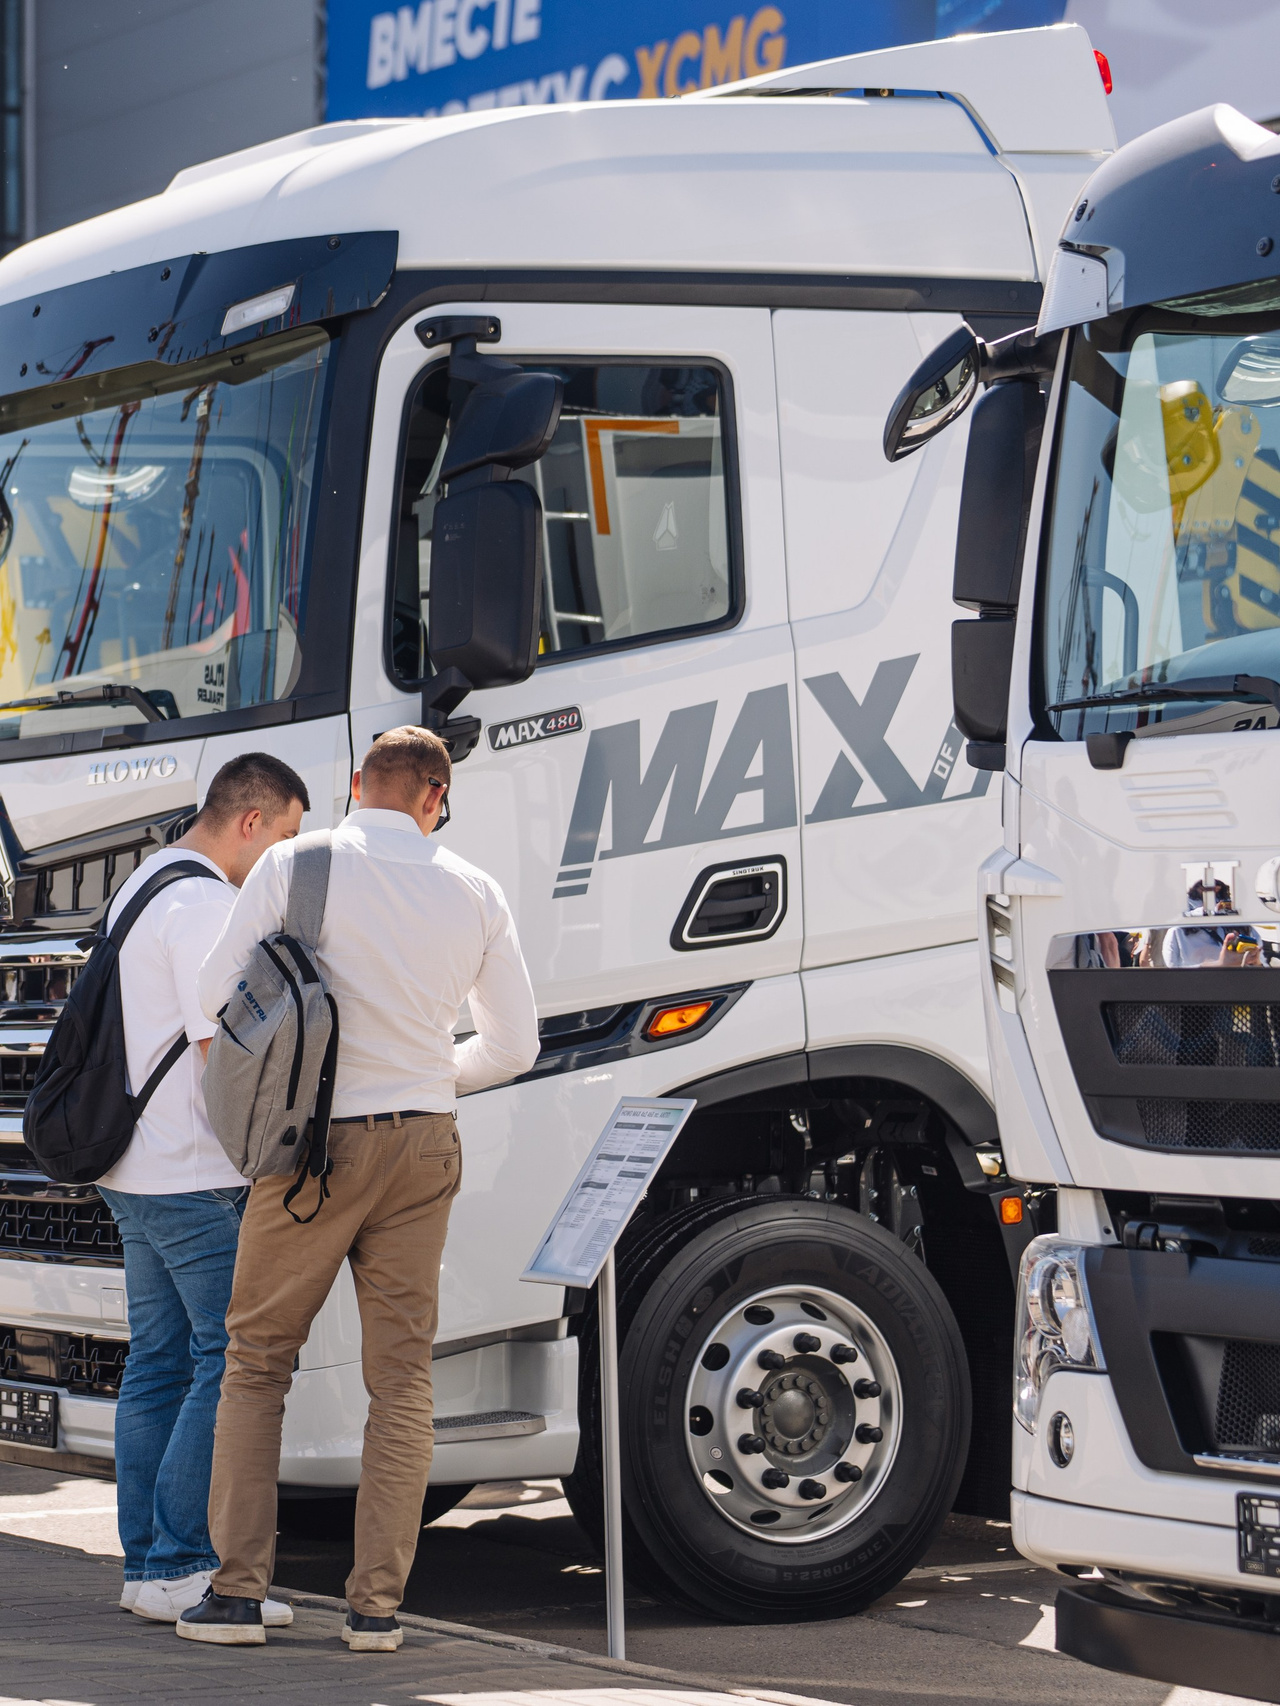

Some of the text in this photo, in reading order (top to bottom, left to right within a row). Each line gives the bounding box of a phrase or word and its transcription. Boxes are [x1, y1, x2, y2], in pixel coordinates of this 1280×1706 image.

[636, 5, 787, 99] XCMG
[494, 712, 578, 748] MAX 480
[86, 754, 178, 786] HOWO
[556, 653, 950, 875] MAX
